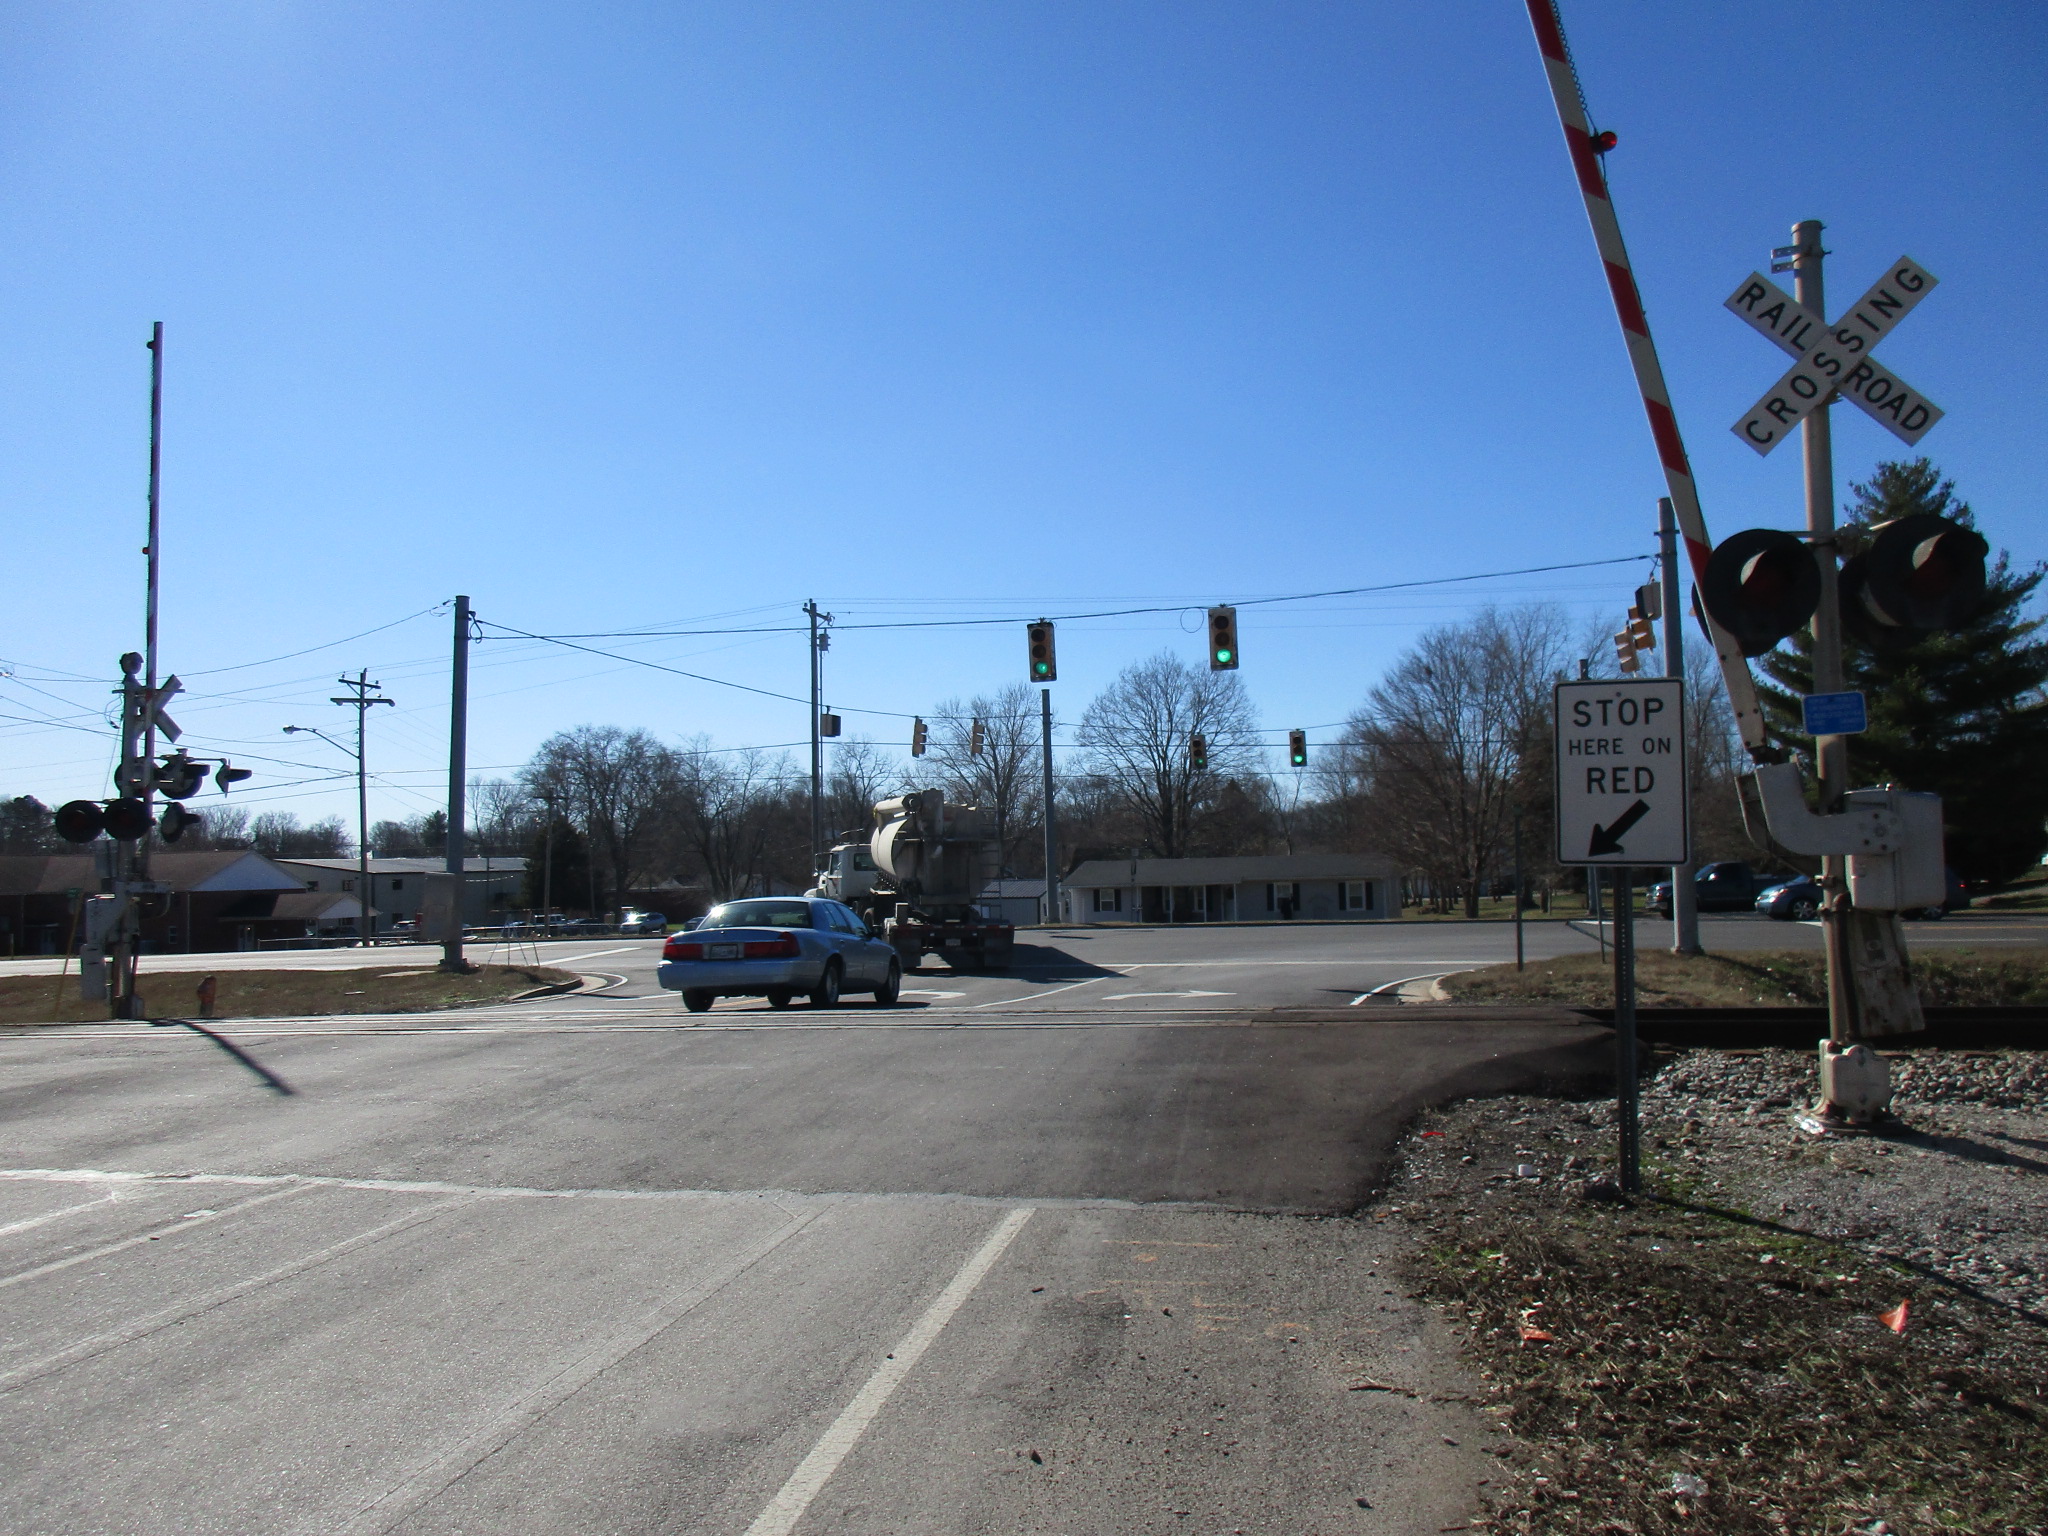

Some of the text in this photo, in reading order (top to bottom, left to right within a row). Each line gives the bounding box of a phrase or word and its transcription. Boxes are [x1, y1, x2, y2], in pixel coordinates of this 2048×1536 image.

[1736, 281, 1930, 432] RAIL ROAD
[1745, 267, 1925, 446] CROSSING
[1573, 697, 1664, 728] STOP
[1569, 737, 1671, 755] HERE ON
[1587, 766, 1655, 794] RED
